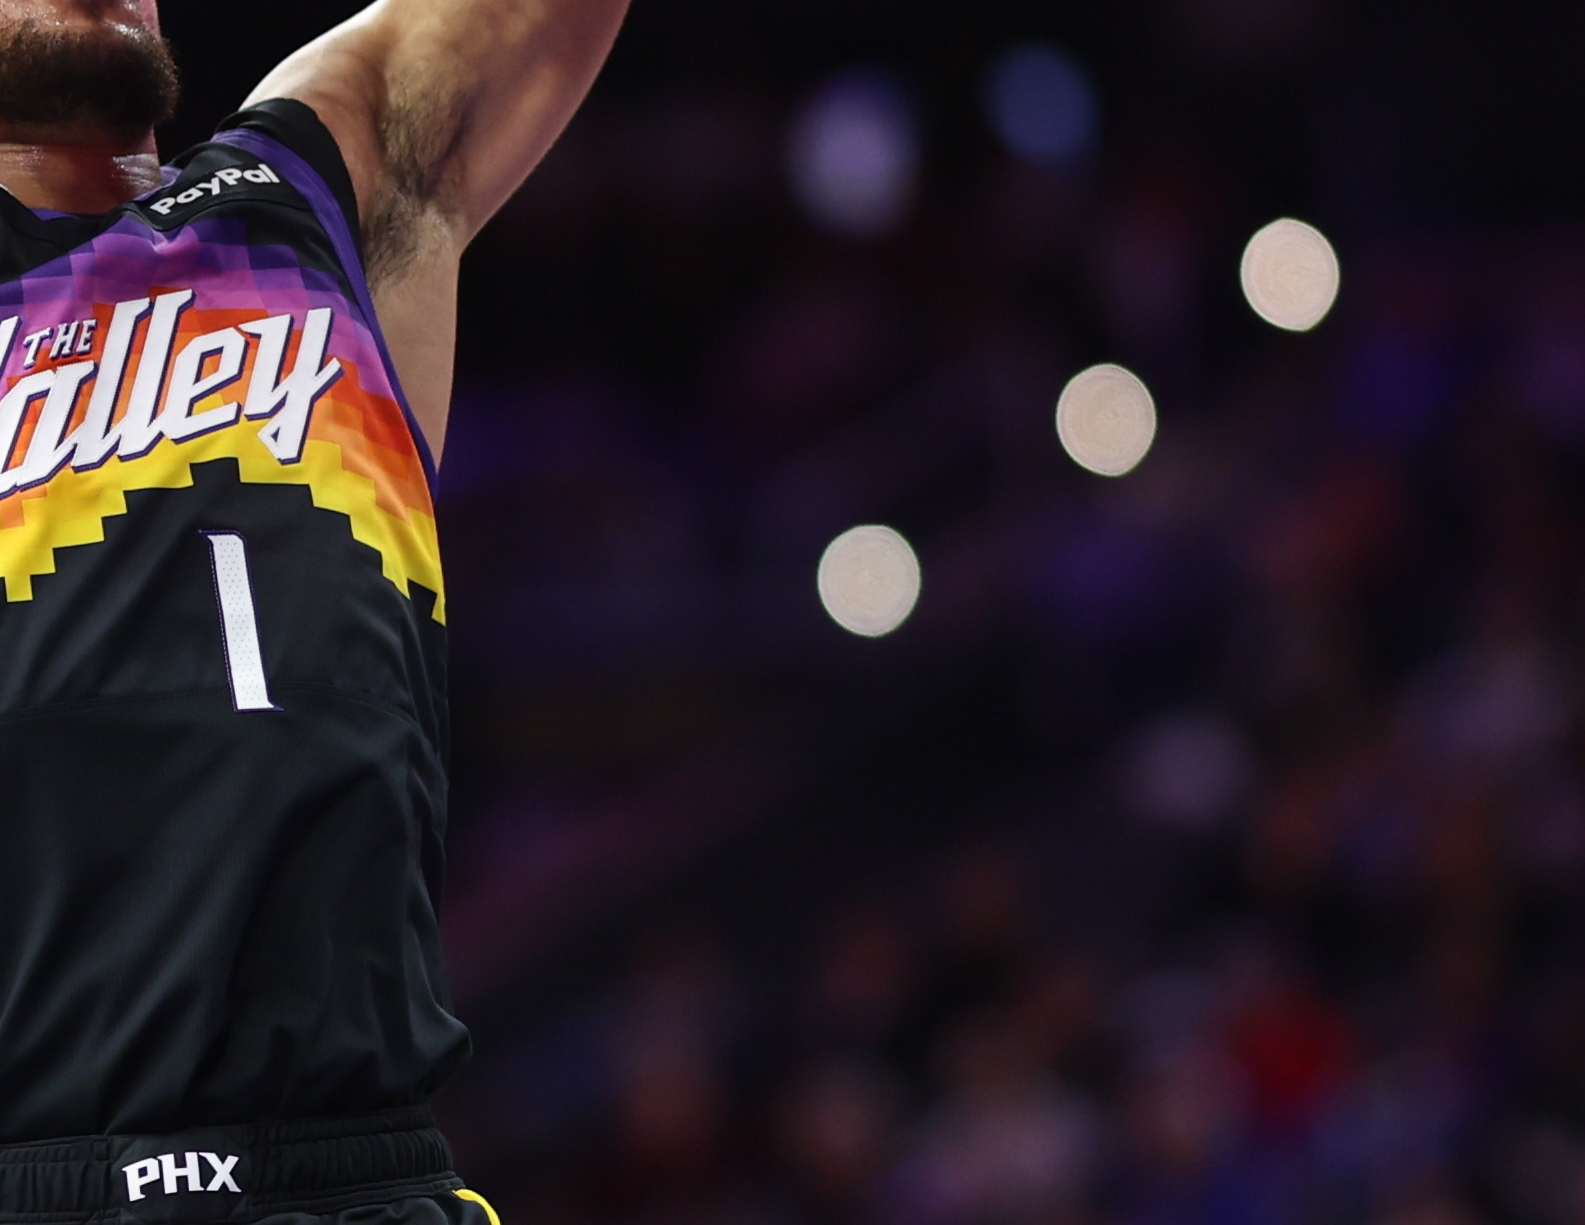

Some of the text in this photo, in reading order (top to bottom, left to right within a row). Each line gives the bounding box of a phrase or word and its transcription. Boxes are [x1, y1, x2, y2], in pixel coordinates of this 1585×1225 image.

[149, 163, 281, 216] PayPal
[23, 317, 98, 368] THE
[199, 529, 283, 712] 1
[121, 1151, 243, 1202] PHX
